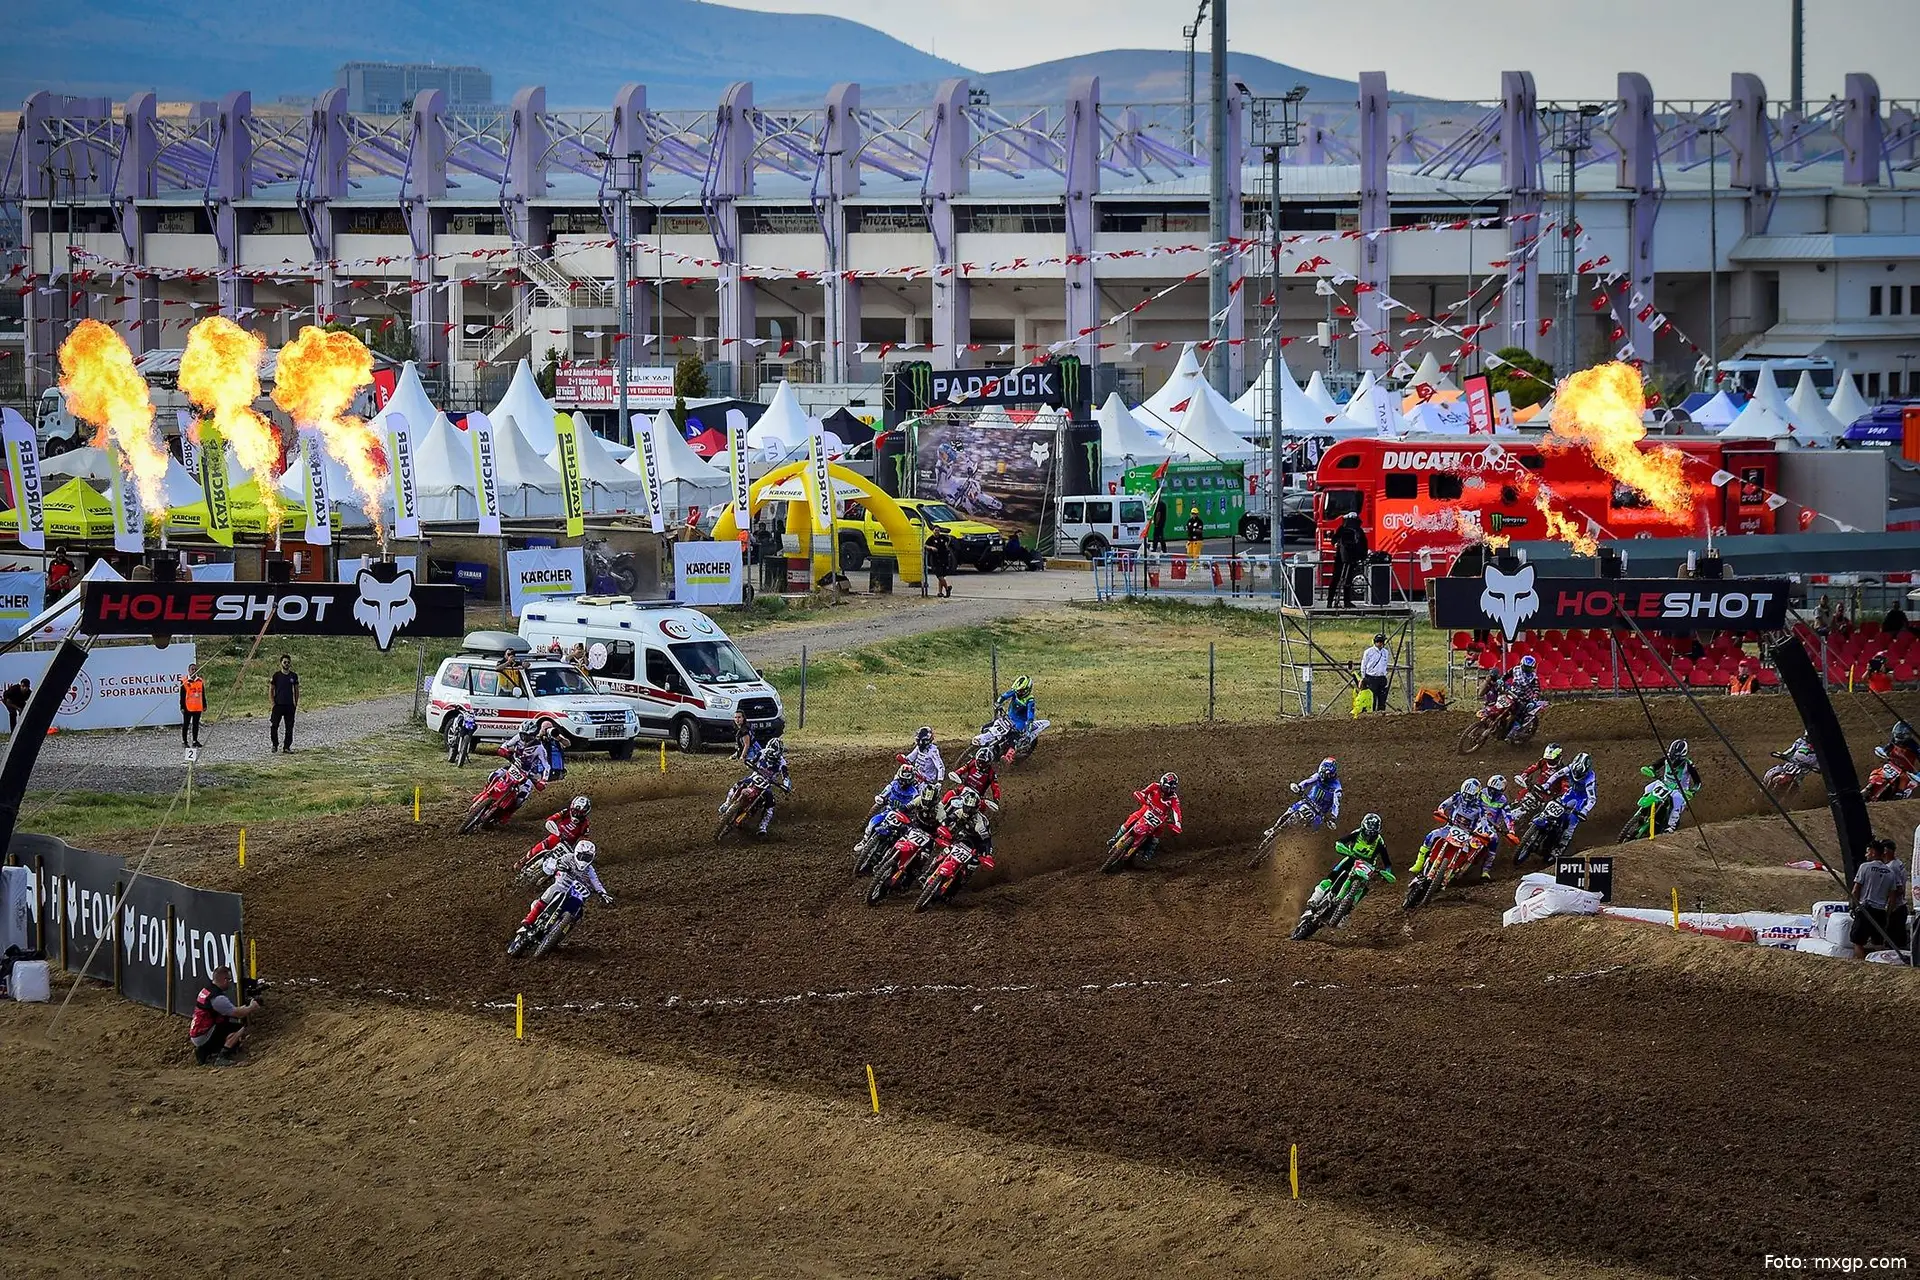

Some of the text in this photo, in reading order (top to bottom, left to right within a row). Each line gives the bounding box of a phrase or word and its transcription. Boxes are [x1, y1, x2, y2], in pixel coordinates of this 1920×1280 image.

[933, 373, 1053, 400] PADDOCK
[686, 561, 731, 576] KÄRCHER
[521, 569, 572, 584] KÄRCHER
[100, 594, 333, 622] HOLESHOT
[1555, 591, 1773, 618] HOLESHOT
[669, 624, 689, 634] 112
[100, 673, 182, 687] T.C. GENÇLİK VE
[100, 688, 126, 697] SPOR
[188, 751, 194, 759] 2
[1547, 801, 1564, 816] 959
[1143, 812, 1161, 828] 32
[911, 831, 926, 845] 70
[1451, 829, 1466, 842] 96
